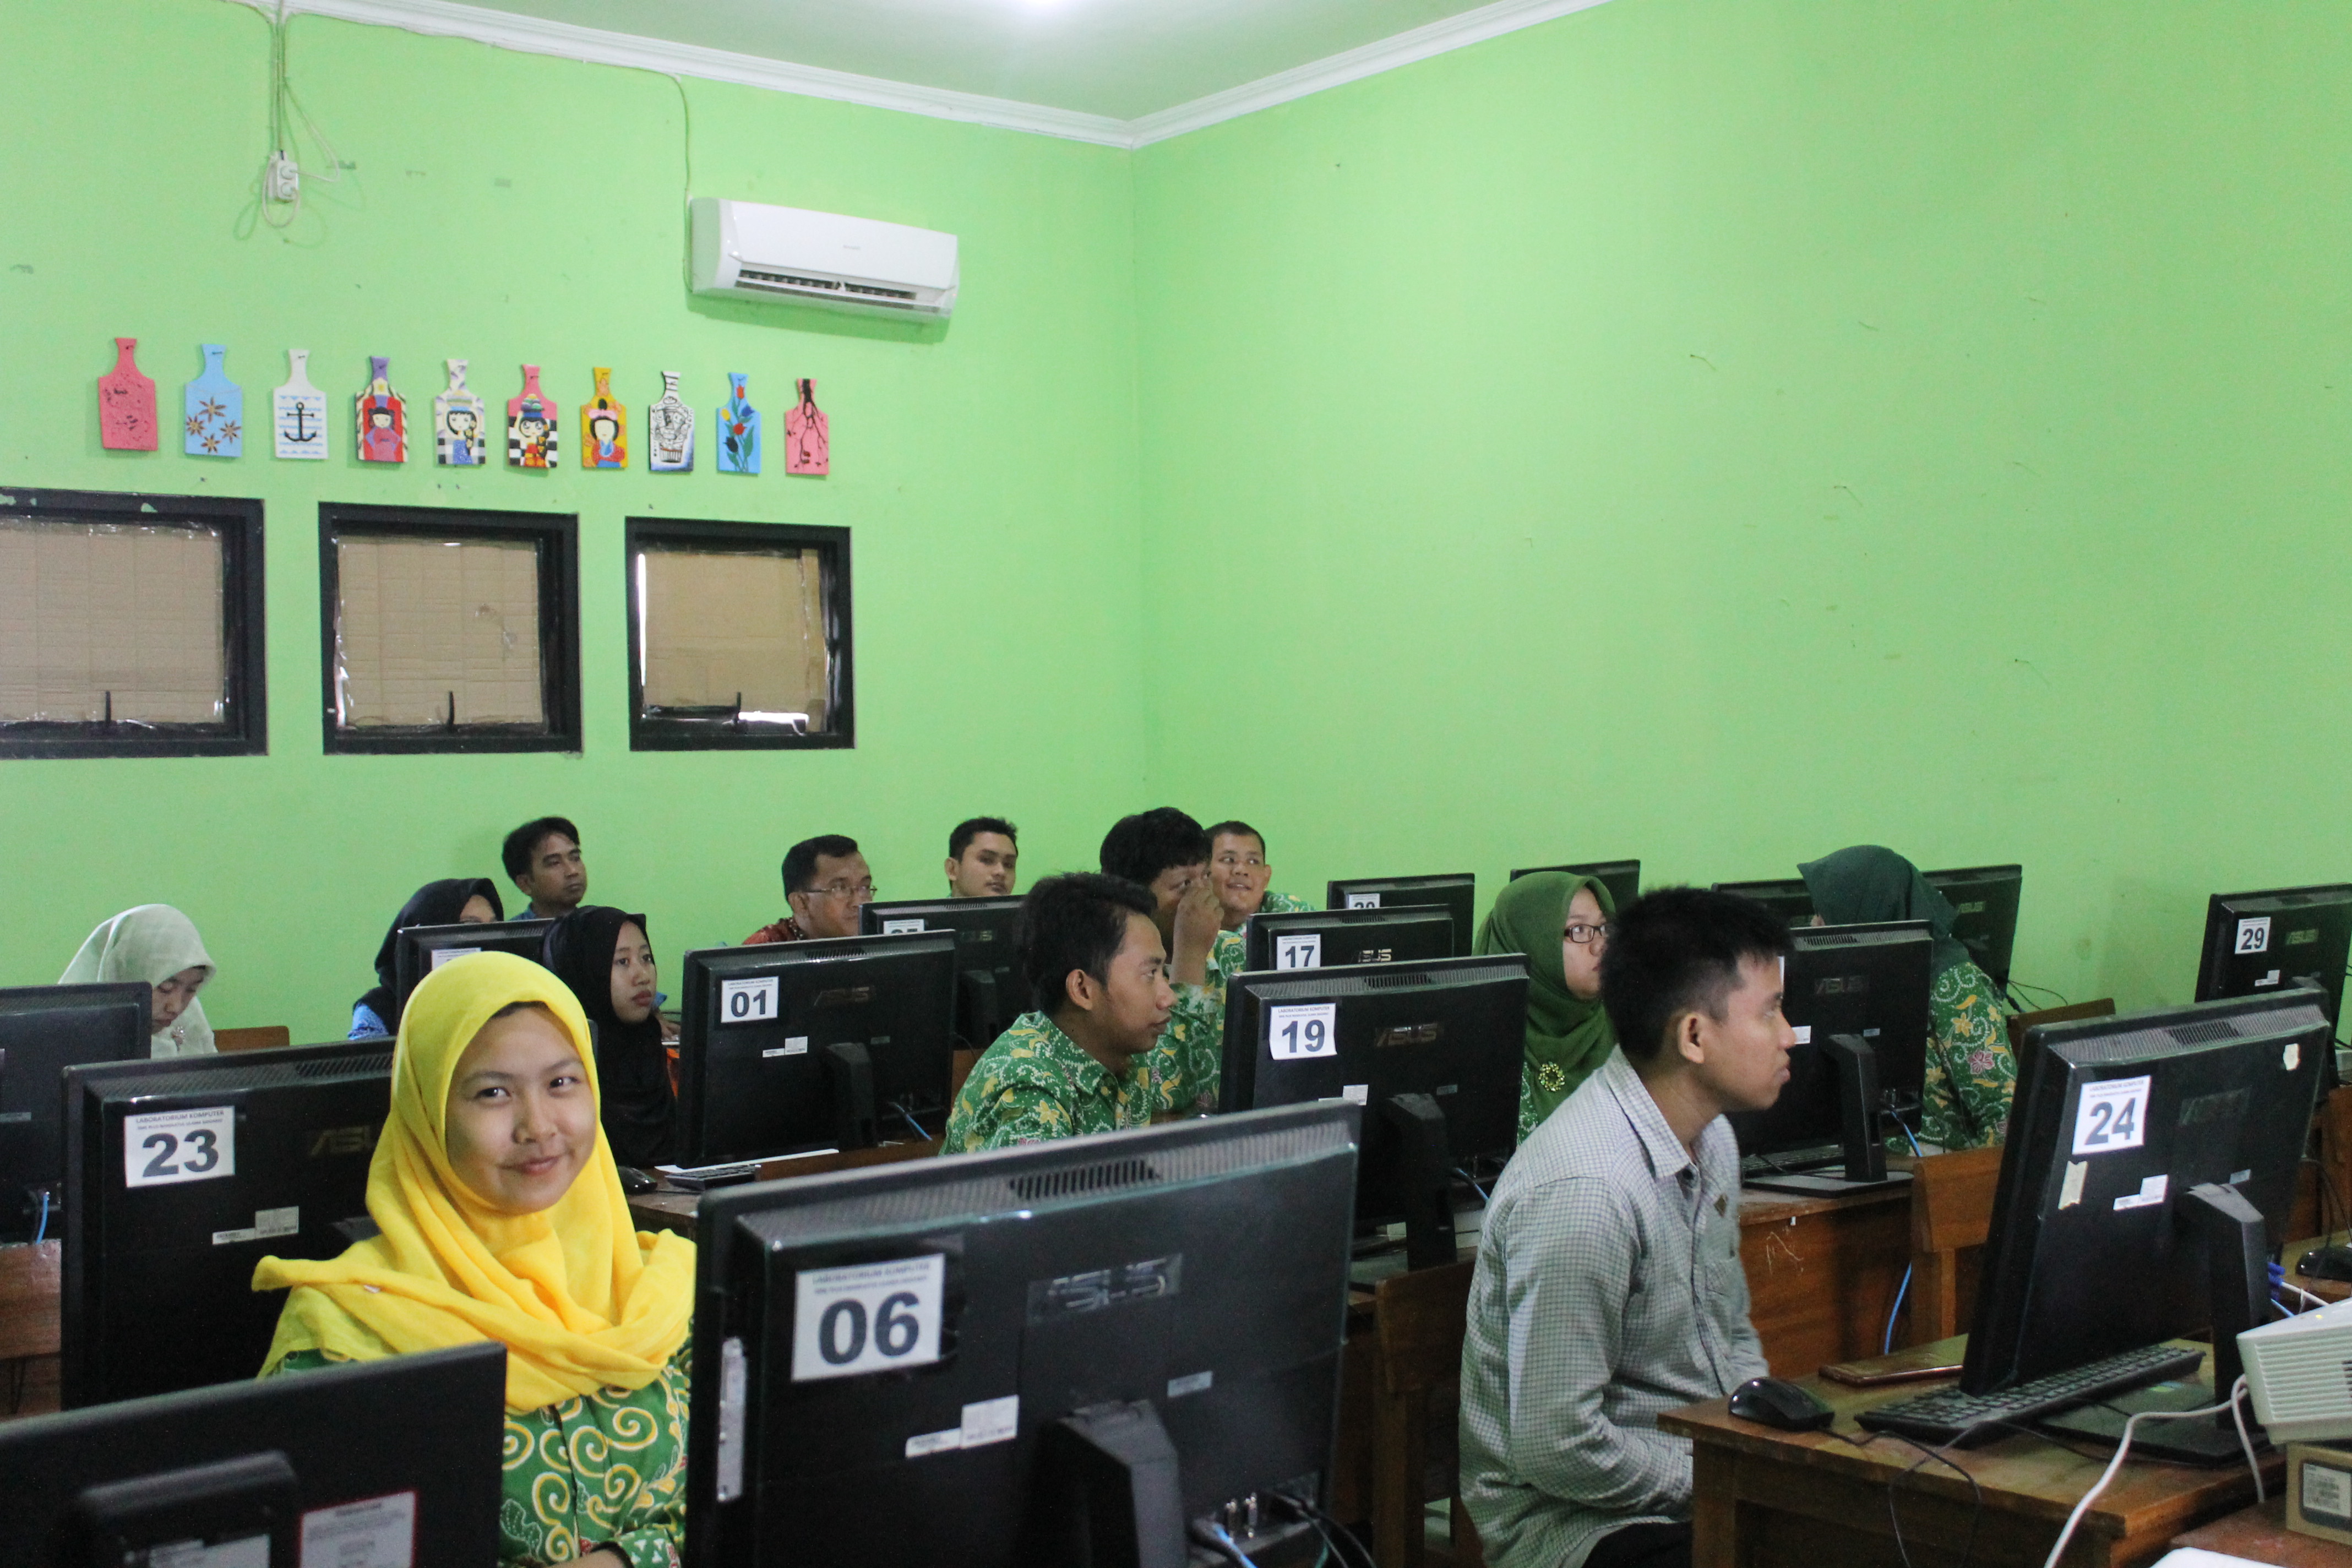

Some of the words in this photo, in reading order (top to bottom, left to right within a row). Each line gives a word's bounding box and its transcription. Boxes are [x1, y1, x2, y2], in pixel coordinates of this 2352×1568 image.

[2240, 927, 2264, 950] 29
[1285, 945, 1314, 967] 17
[731, 989, 766, 1017] 01
[1282, 1020, 1325, 1053] 19
[1376, 1023, 1437, 1047] ASUS
[137, 1114, 188, 1123] LABORATORIUM
[189, 1110, 225, 1118] KOMPUTER
[2084, 1097, 2136, 1145] 24
[143, 1129, 219, 1178] 23
[819, 1291, 919, 1365] 06
